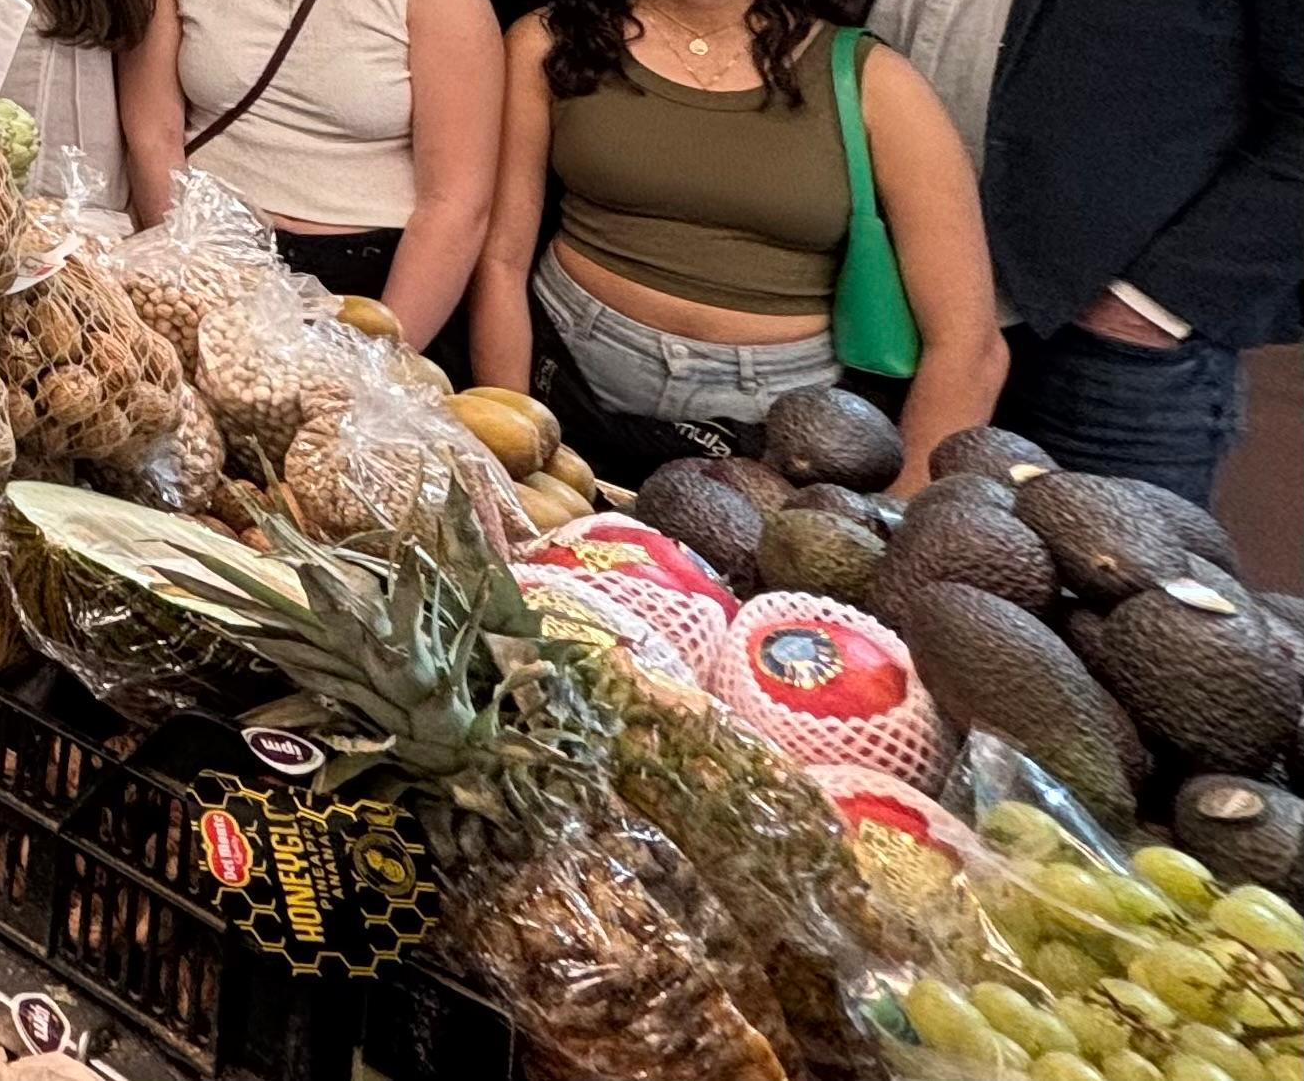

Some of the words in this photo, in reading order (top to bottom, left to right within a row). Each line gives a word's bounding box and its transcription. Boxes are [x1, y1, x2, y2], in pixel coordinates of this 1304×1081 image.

[260, 737, 306, 761] ipm
[212, 814, 233, 859] Monte
[223, 859, 239, 881] Del
